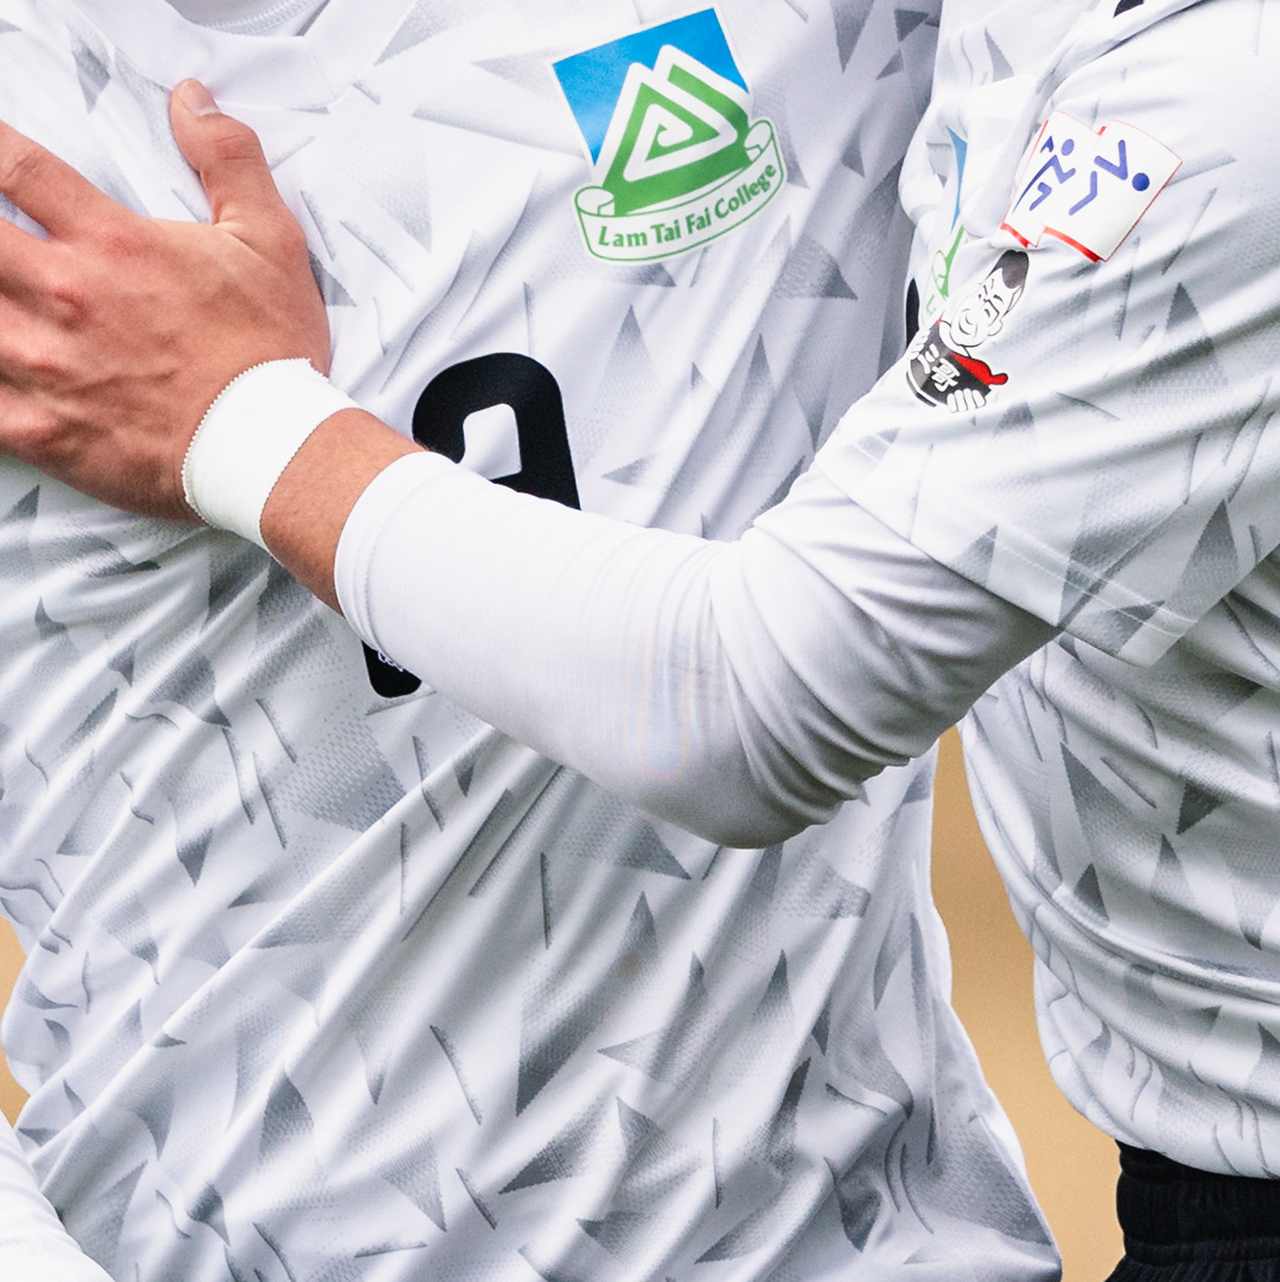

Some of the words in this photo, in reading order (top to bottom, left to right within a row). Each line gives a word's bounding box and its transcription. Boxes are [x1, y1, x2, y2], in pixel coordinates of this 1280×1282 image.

[597, 224, 648, 248] Lam
[650, 219, 681, 245] Tai
[686, 207, 713, 235] Fai
[714, 164, 778, 219] College
[917, 343, 960, 392] 三哥
